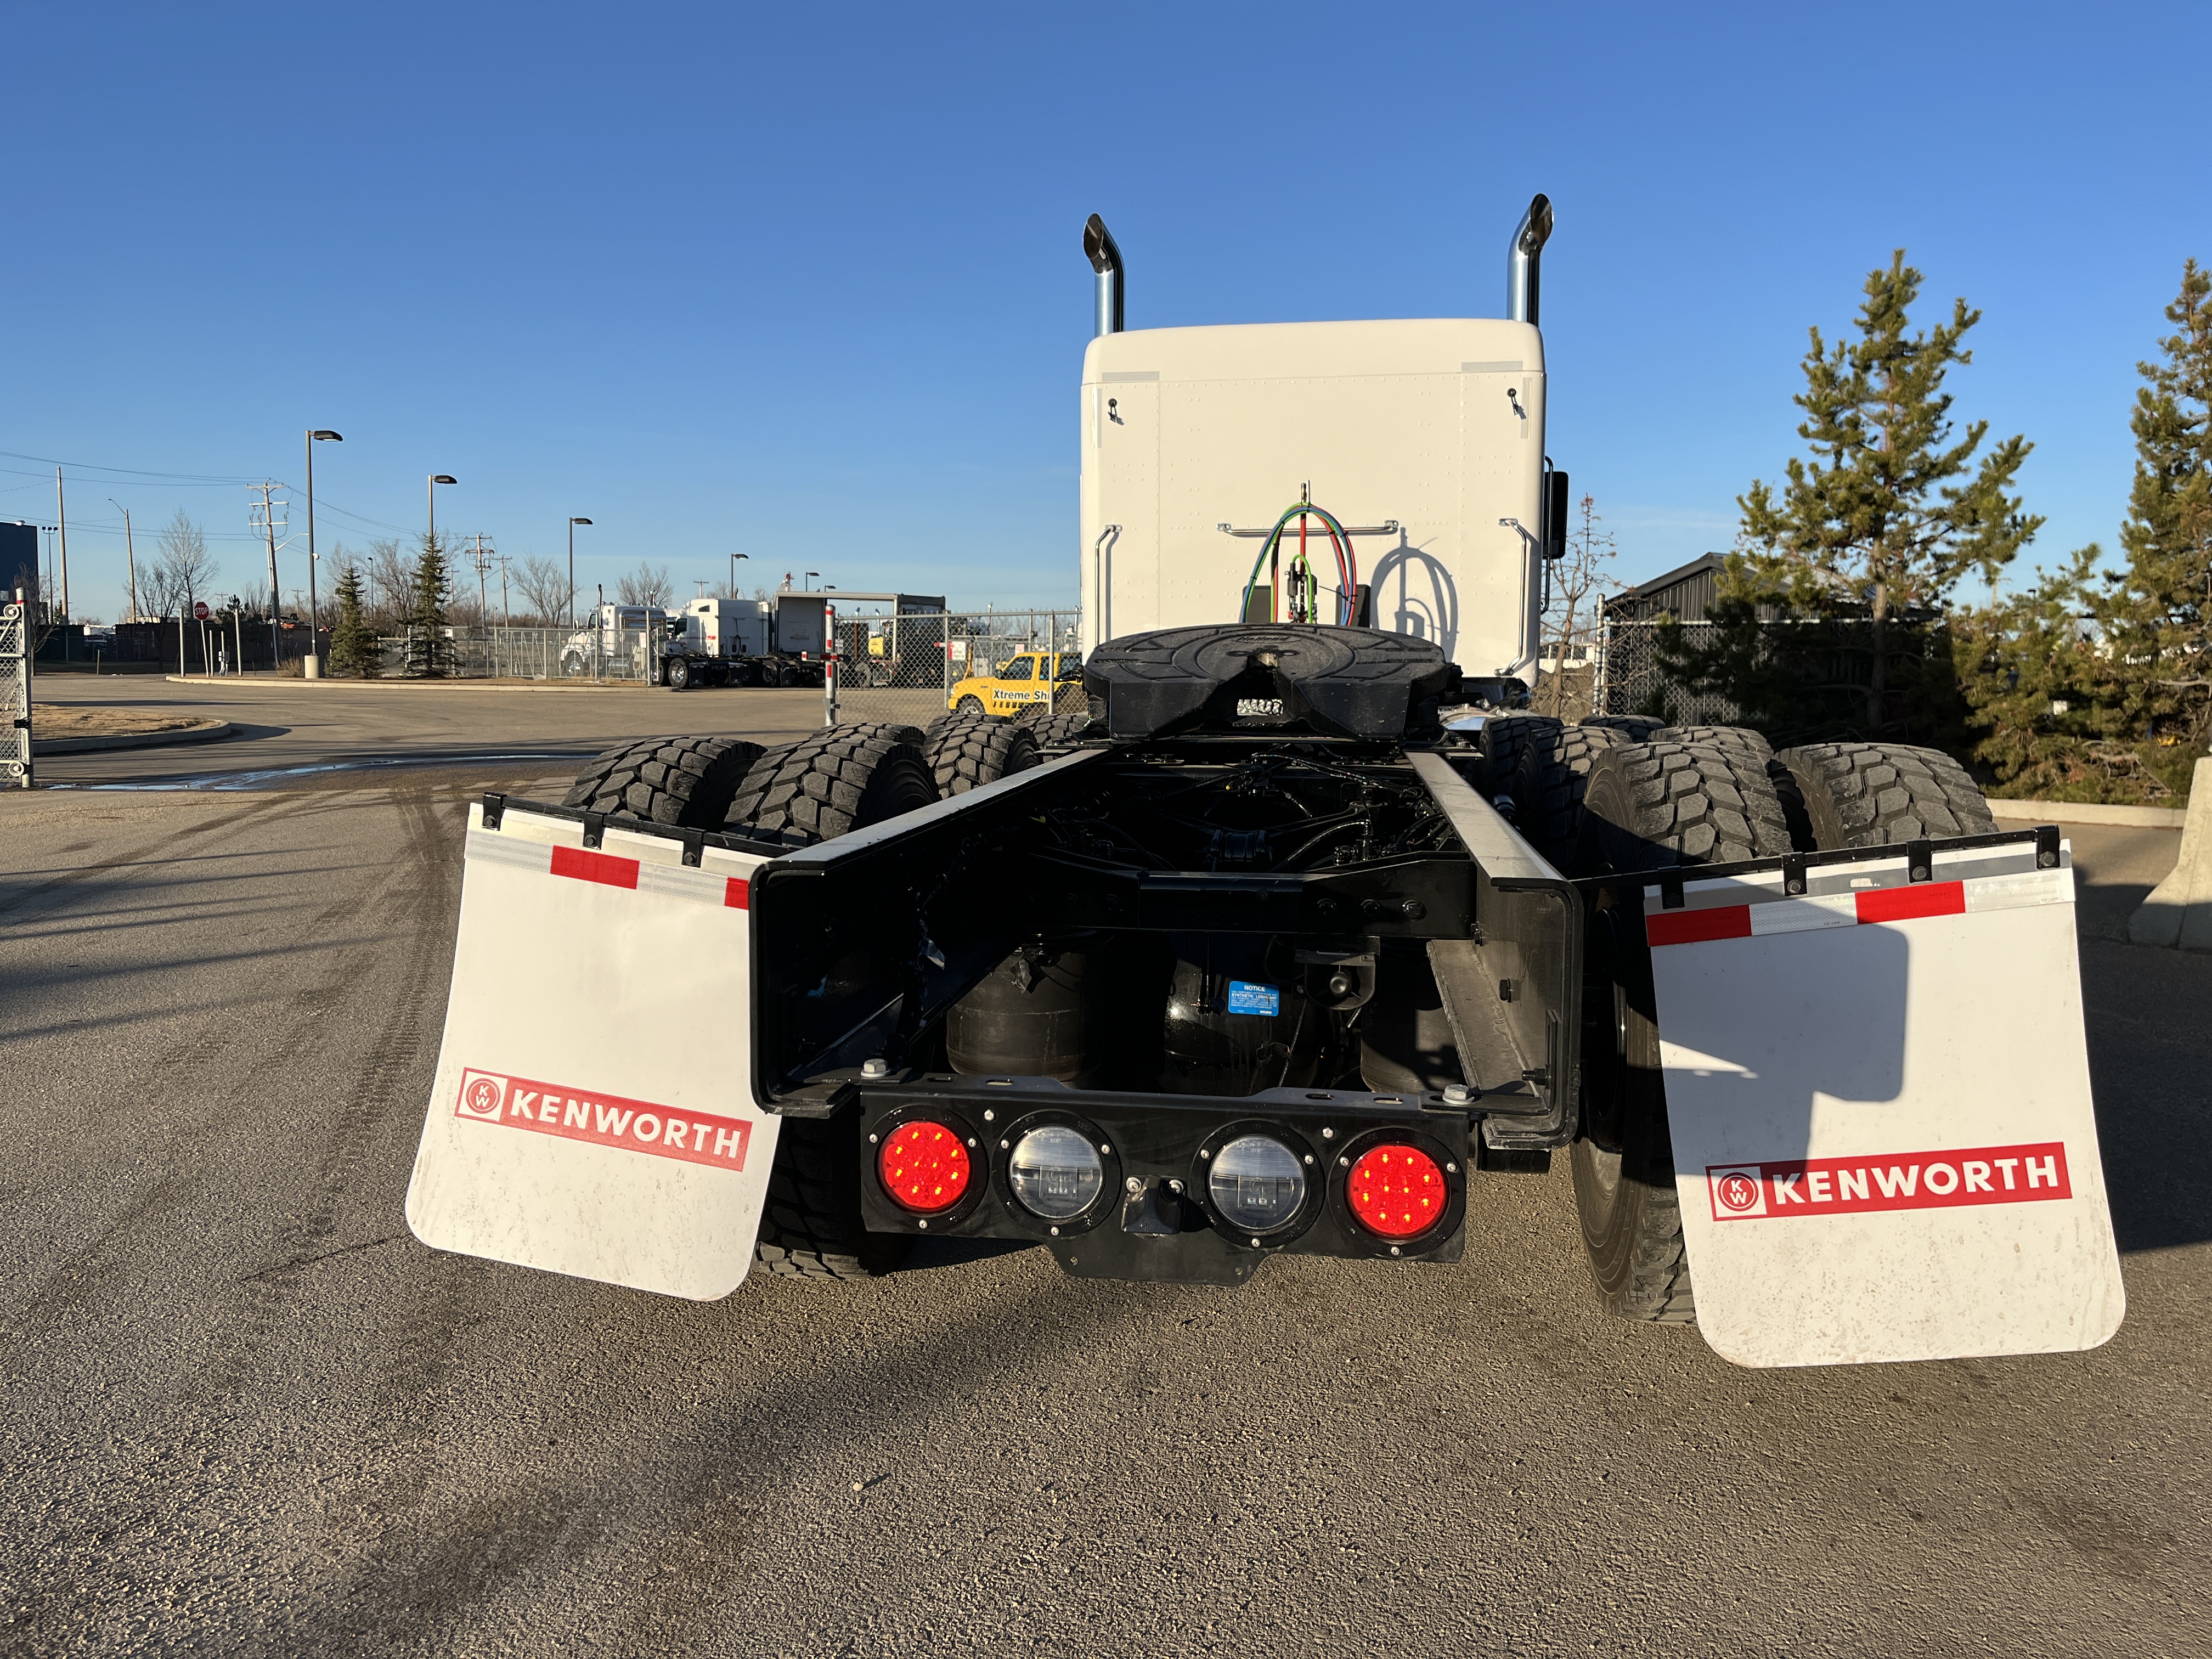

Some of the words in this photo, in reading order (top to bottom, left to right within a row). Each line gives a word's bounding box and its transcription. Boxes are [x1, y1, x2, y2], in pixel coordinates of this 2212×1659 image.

[993, 690, 1030, 699] Xtreme
[510, 1088, 741, 1158] KENWORTH
[1773, 1155, 2058, 1205] KENWORTH
